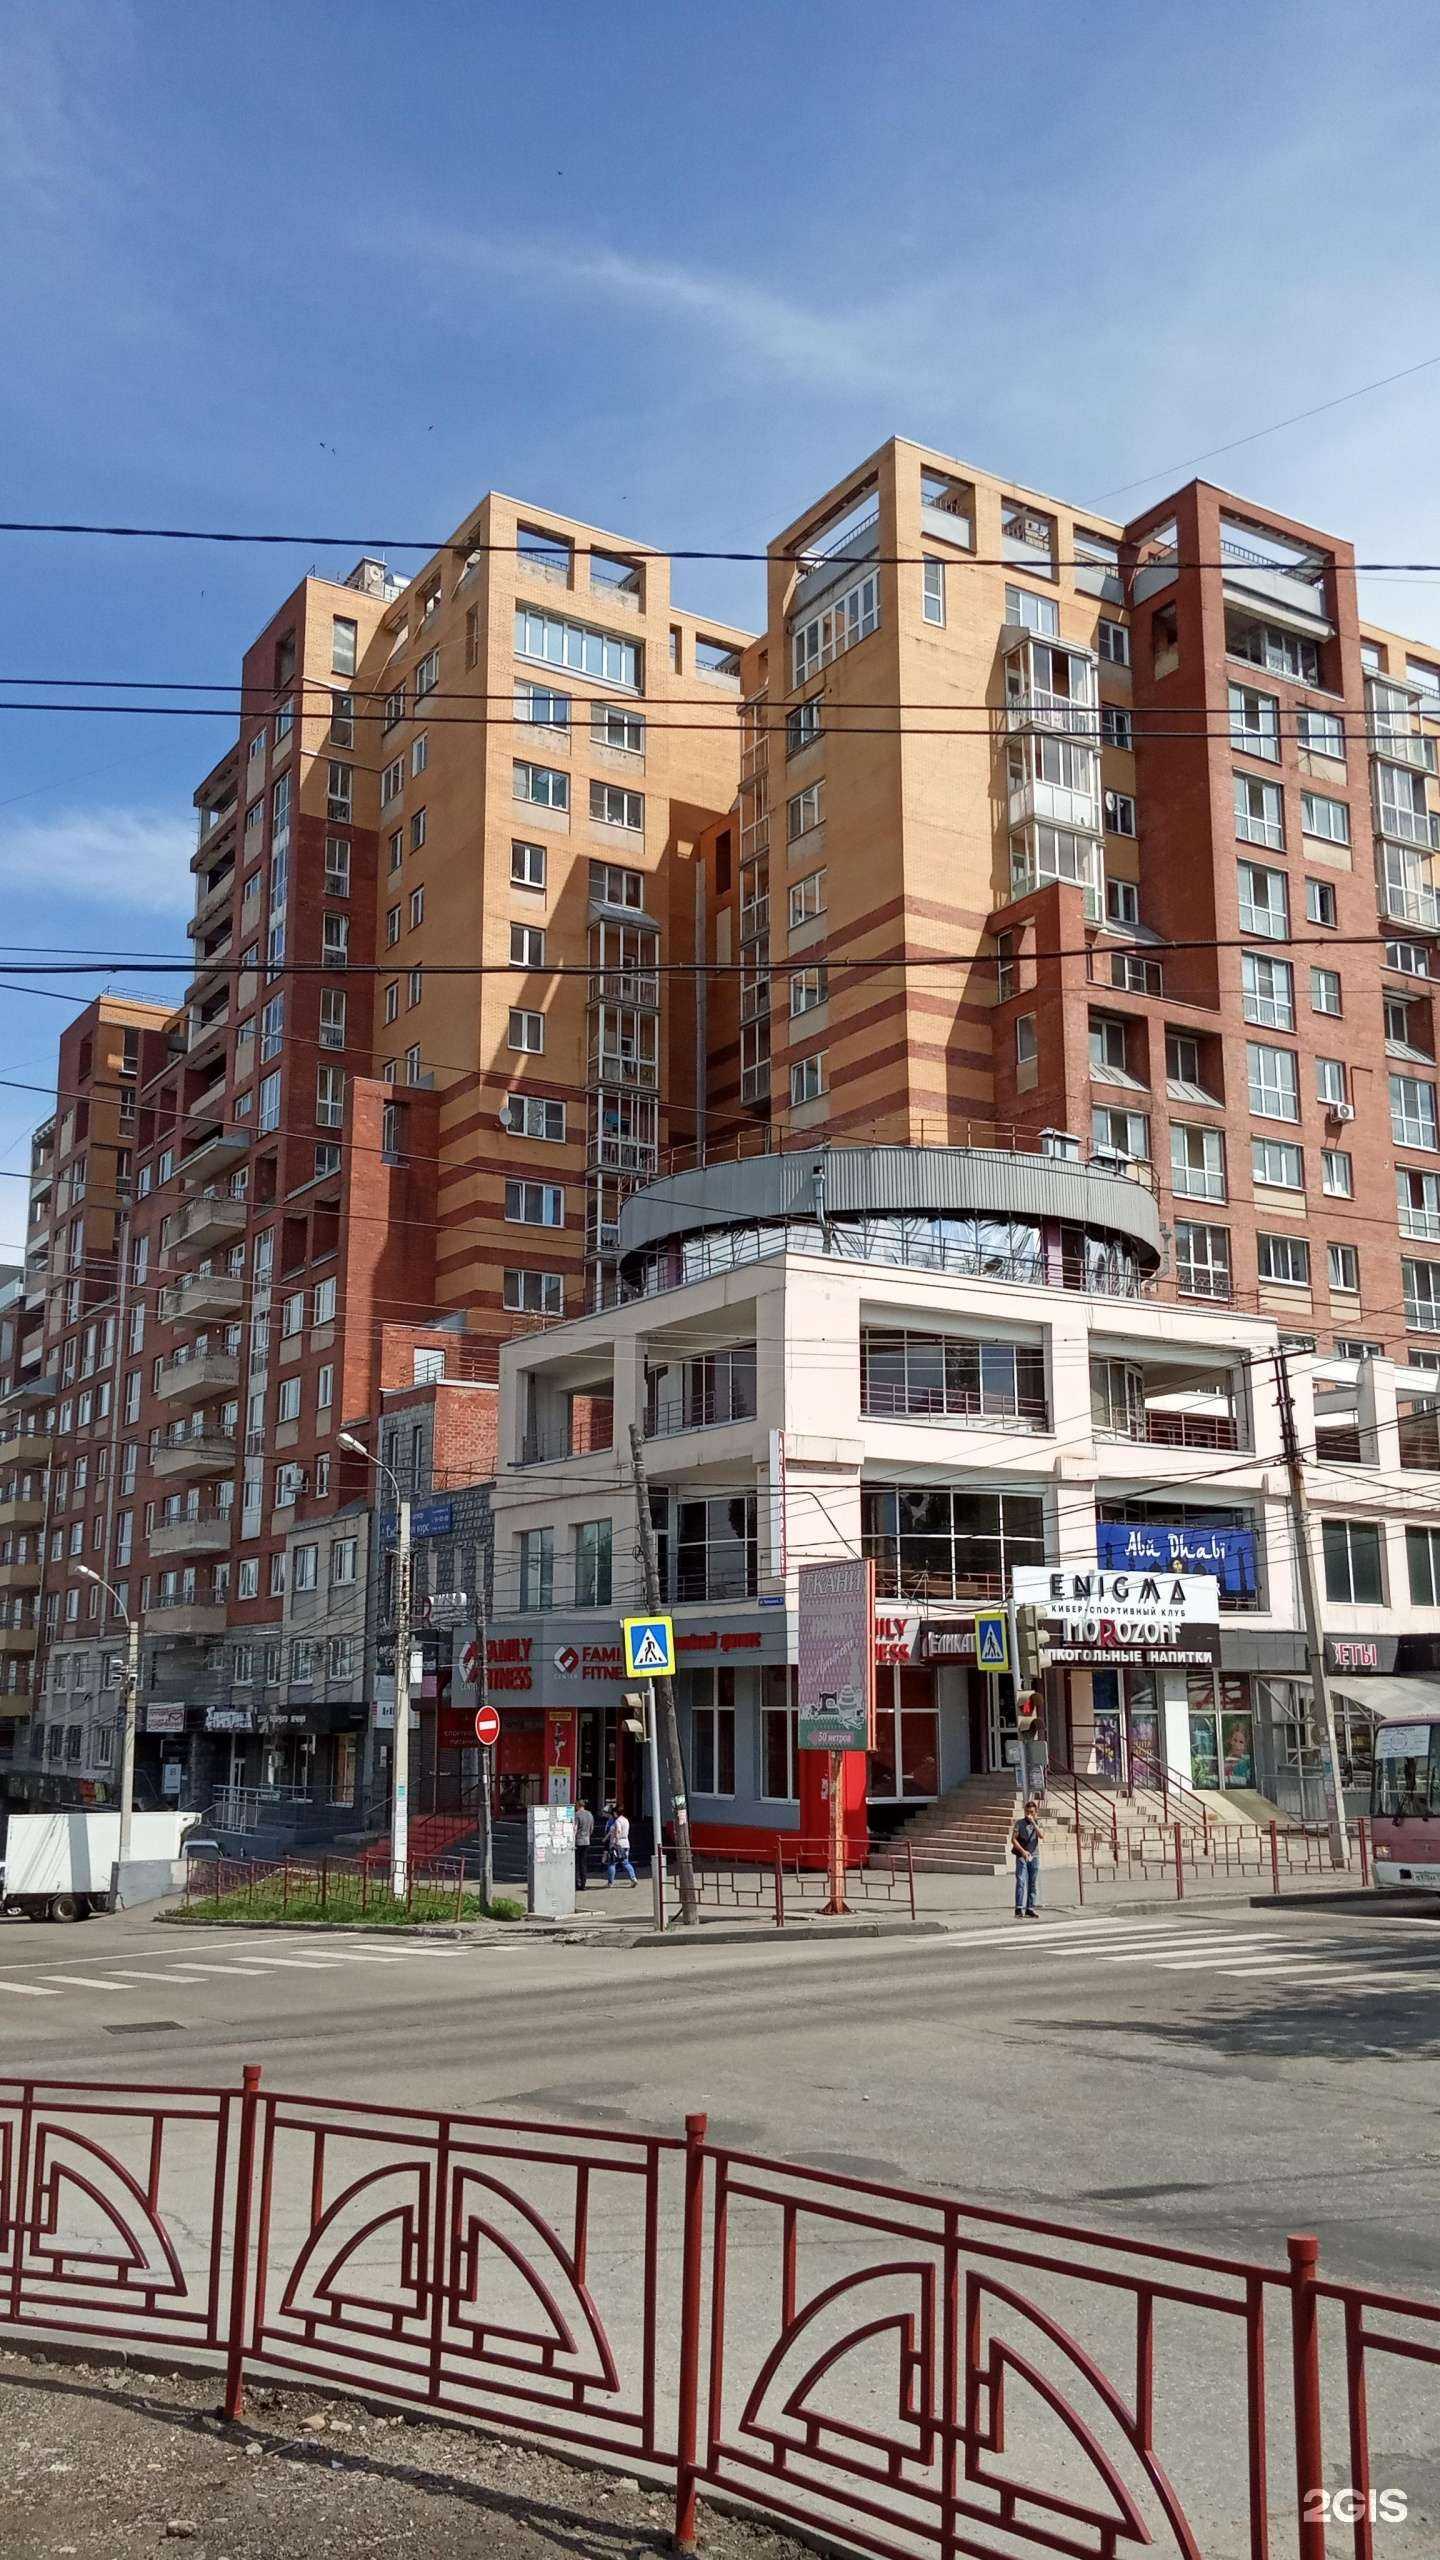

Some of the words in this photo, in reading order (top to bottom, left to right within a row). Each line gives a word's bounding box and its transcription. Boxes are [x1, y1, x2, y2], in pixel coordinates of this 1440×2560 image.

[1050, 1573, 1186, 1603] ENIGMA
[1161, 1608, 1186, 1617] КЛУБ
[1063, 1619, 1182, 1648] MOROZOFF
[1147, 1650, 1213, 1664] НАПИТКИ
[818, 1732, 828, 1742] 50
